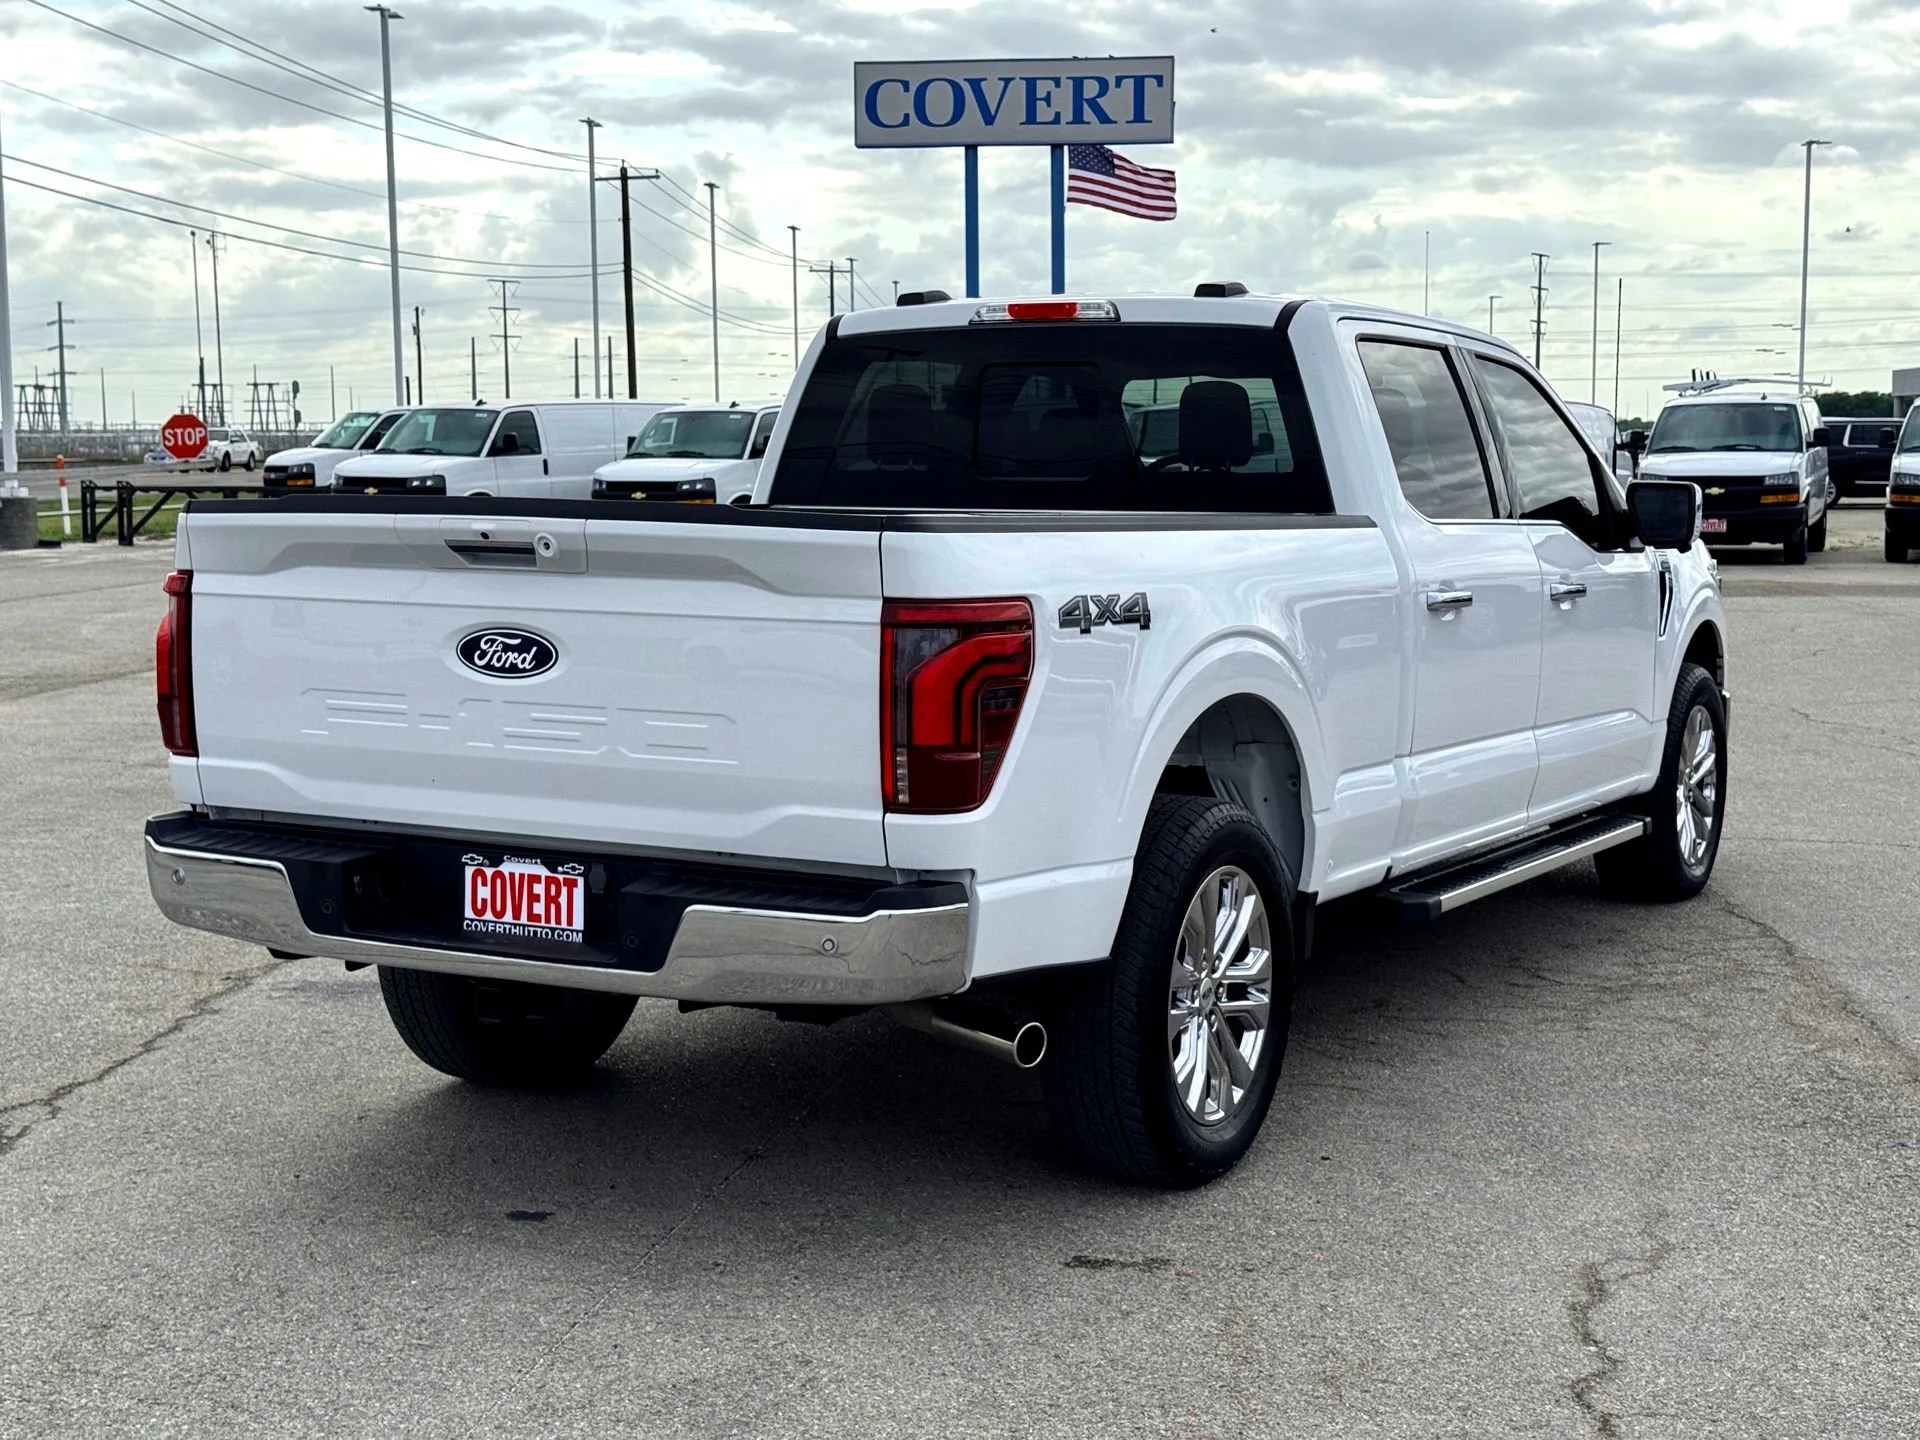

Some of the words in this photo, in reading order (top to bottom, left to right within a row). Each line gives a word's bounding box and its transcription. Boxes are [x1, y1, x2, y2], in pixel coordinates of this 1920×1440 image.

[864, 74, 1164, 129] COVERT
[164, 427, 206, 447] STOP
[474, 635, 538, 669] Ford
[503, 855, 542, 865] Covert
[471, 867, 578, 927] COVERT
[463, 919, 583, 943] COVERTHUTTO.COM
